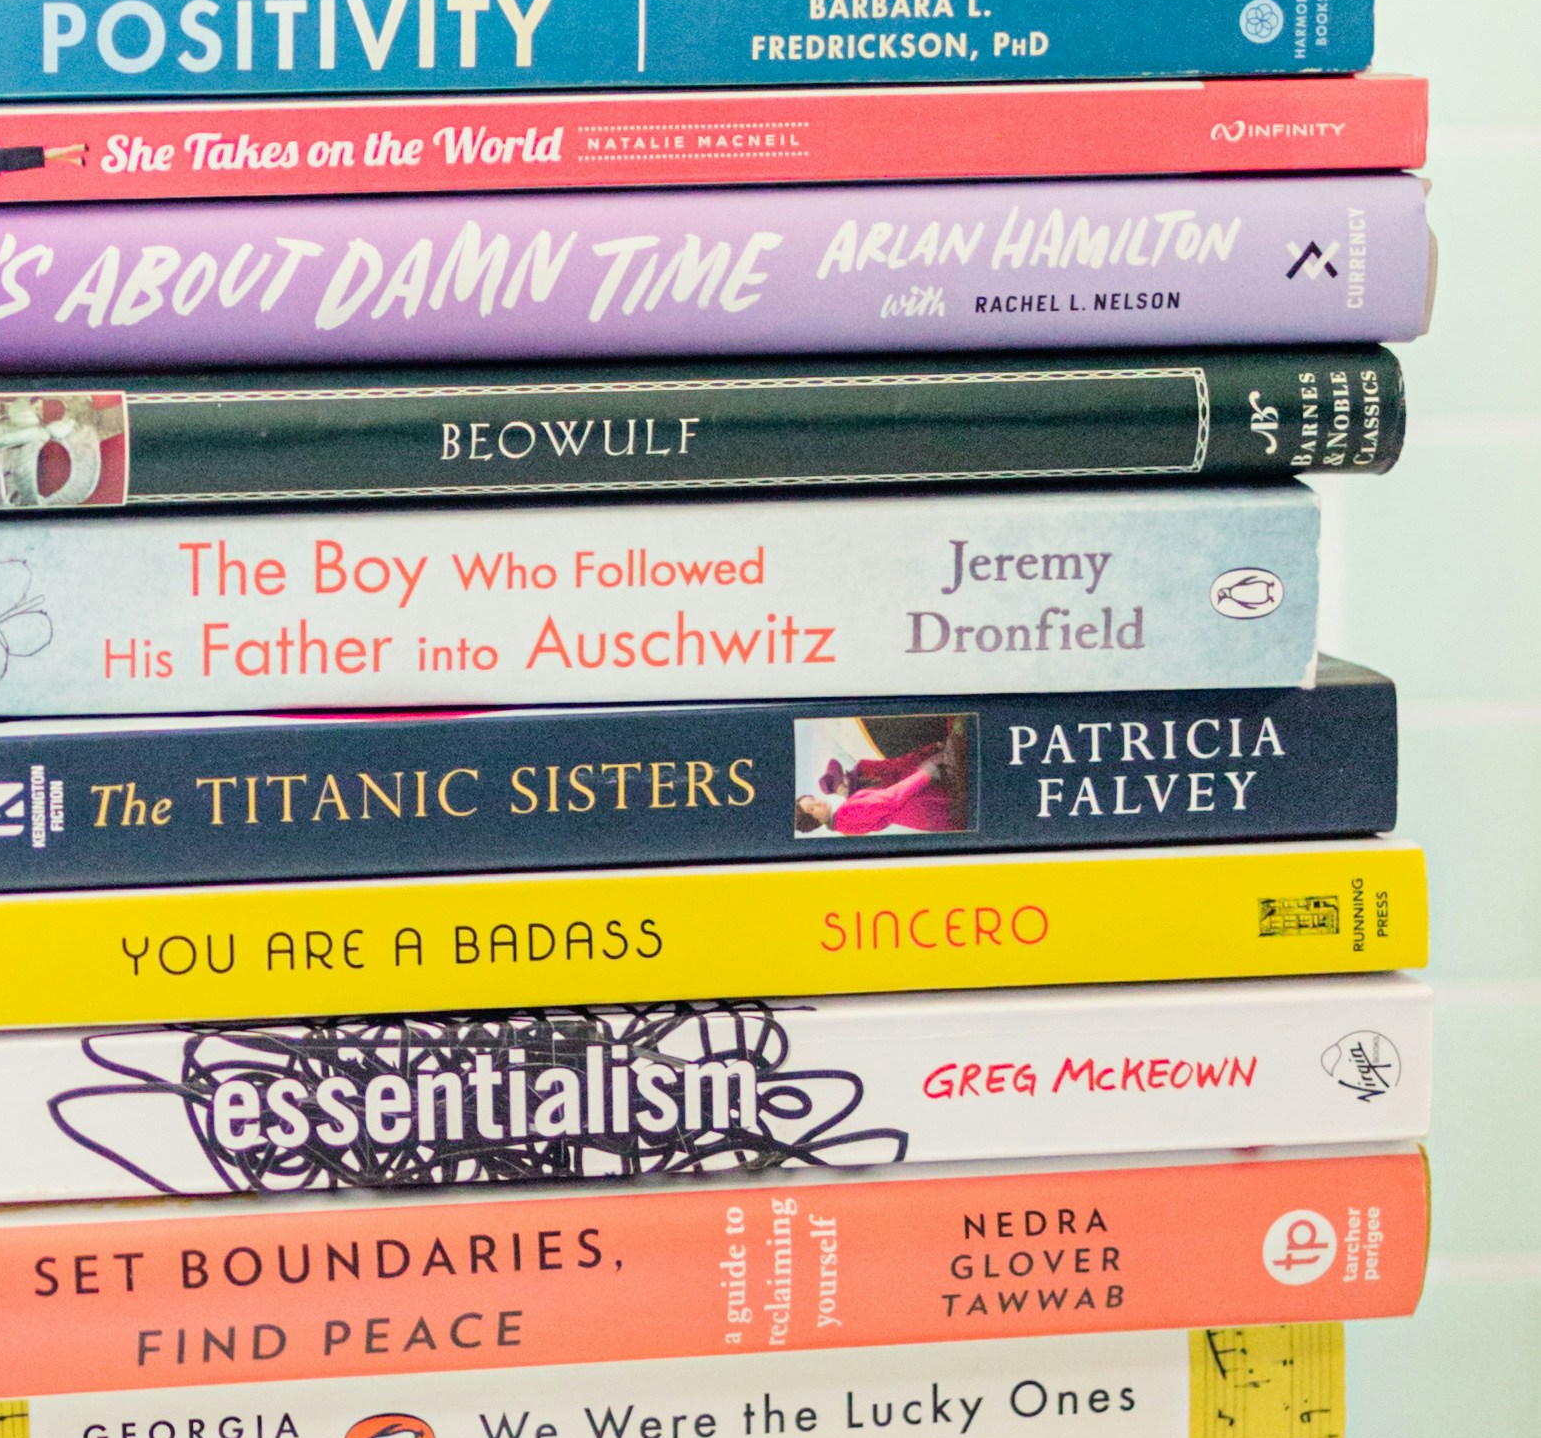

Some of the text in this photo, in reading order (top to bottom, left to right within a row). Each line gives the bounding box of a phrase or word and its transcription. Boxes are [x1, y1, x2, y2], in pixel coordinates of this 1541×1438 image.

[751, 32, 978, 64] FREDRICKSON,
[100, 126, 563, 174] She Takes on the World
[587, 134, 800, 150] NATALIE MACNEIL
[1249, 122, 1346, 138] INFINITY
[818, 206, 1242, 279] ARLAN HAMILTON
[1347, 207, 1368, 309] CURRENCY
[55, 236, 326, 329] ABOUT
[314, 219, 579, 331] DAMN
[587, 231, 783, 323] TIME
[440, 418, 701, 461] BEOWULF
[1290, 372, 1319, 466] BARNES
[1322, 371, 1350, 466] & NOBLE
[1353, 370, 1380, 465] CLASSICS
[178, 539, 765, 608] The Boy Who Followed
[942, 540, 1112, 596] Jeremy
[103, 611, 837, 679] His Father into Auschwitz
[905, 606, 1145, 654] Dronfield
[1008, 717, 1286, 765] PATRICIA
[90, 760, 756, 827] The TITANIC SISTERS
[1036, 770, 1257, 818] FALVEY
[820, 905, 1049, 951] SINCERO
[1352, 878, 1364, 952] RUNNING
[1376, 891, 1388, 937] PRESS
[122, 918, 663, 976] YOU ARE A BADASS
[212, 1046, 759, 1150] essentialism
[923, 1063, 1036, 1100] GREG
[1338, 1041, 1391, 1102] Virgin
[963, 1208, 1106, 1240] NEDRA
[1343, 1206, 1362, 1283] tarcher
[1363, 1206, 1381, 1281] perigee
[34, 1228, 625, 1297] SET BOUNDARIES,
[719, 1207, 752, 1344] a guide to
[764, 1198, 797, 1345] reclaiming
[809, 1214, 842, 1328] yourself
[950, 1248, 1121, 1279] GLOVER
[942, 1286, 1125, 1318] TAWWAB
[137, 1310, 523, 1366] FIND PEACE
[743, 1393, 818, 1437] the
[846, 1383, 985, 1434] Lucky
[1009, 1379, 1138, 1419] Ones
